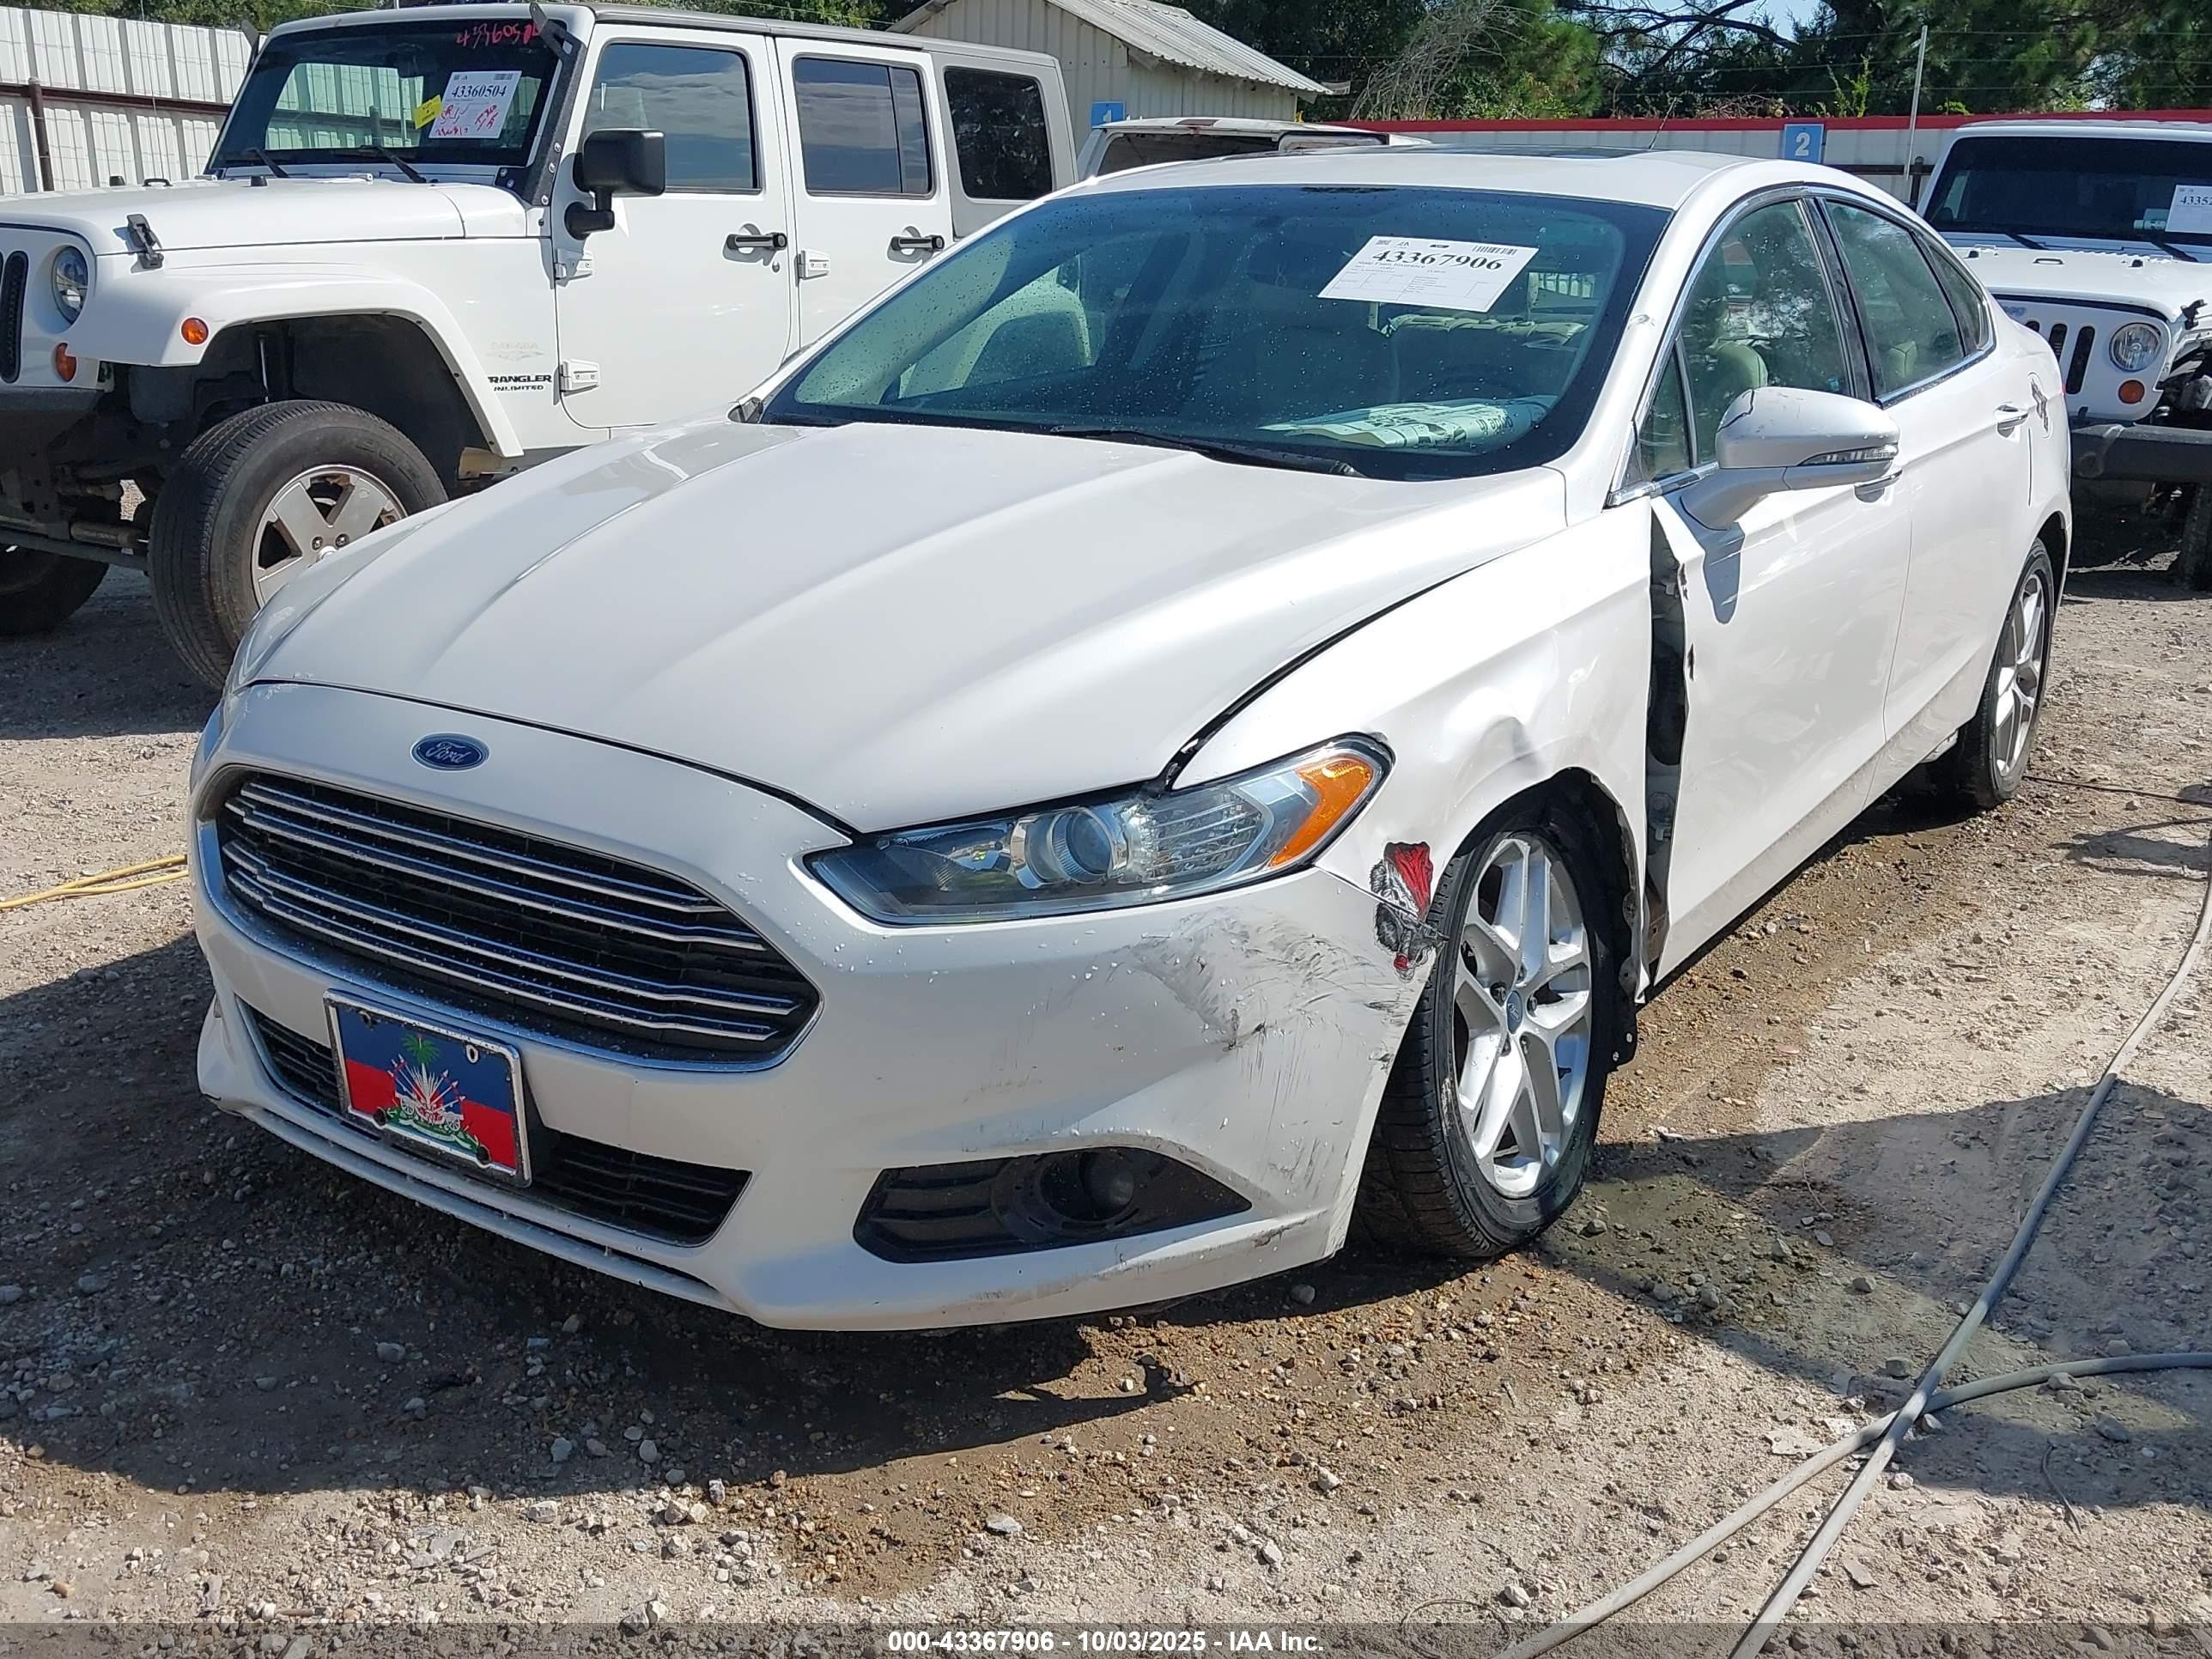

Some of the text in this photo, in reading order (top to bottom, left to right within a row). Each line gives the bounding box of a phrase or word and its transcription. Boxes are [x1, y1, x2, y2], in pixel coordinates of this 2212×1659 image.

[452, 85, 507, 97] 43360504
[1795, 132, 1811, 156] 2
[1372, 250, 1509, 270] 43367906
[488, 374, 552, 384] RANGLER
[426, 741, 472, 764] Ford
